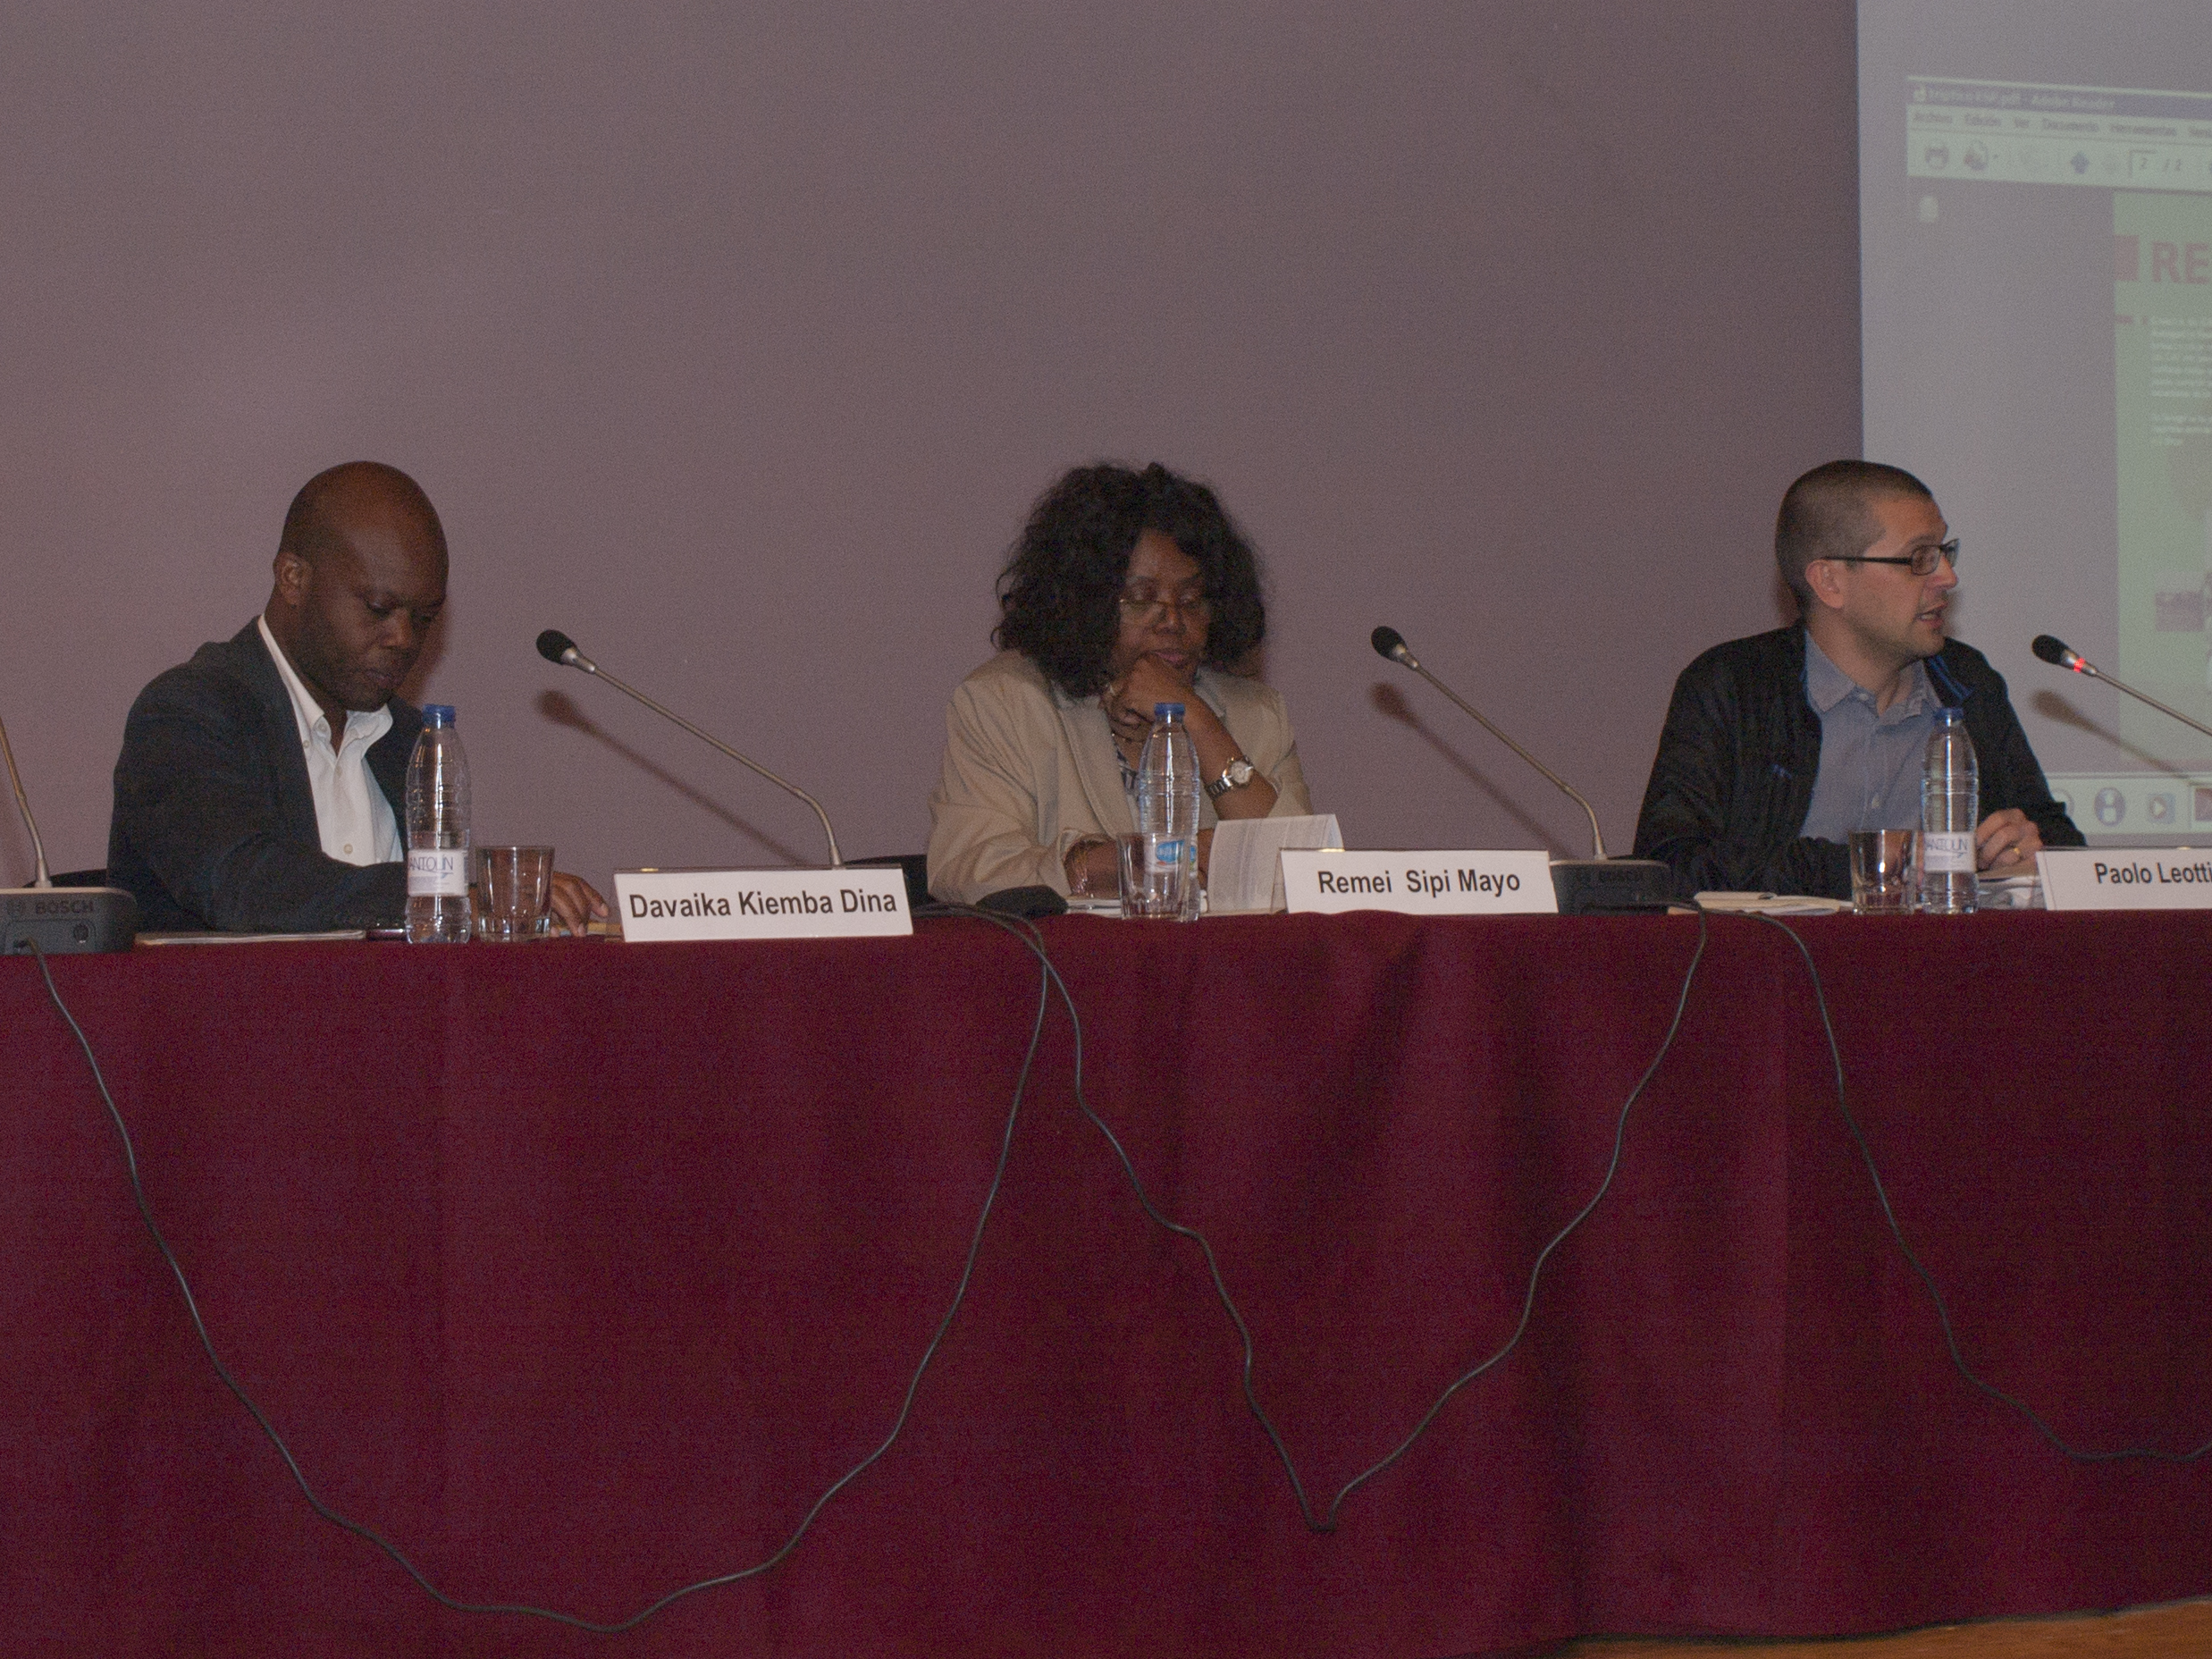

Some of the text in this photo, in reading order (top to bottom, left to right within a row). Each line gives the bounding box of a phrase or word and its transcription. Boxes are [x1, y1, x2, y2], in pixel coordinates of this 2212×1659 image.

[2151, 240, 2210, 284] RE
[1317, 869, 1520, 897] Remei Sipi Mayo
[2094, 862, 2153, 884] Paolo
[34, 900, 95, 915] BOSCH
[629, 888, 896, 918] Davaika Kiemba Dina
